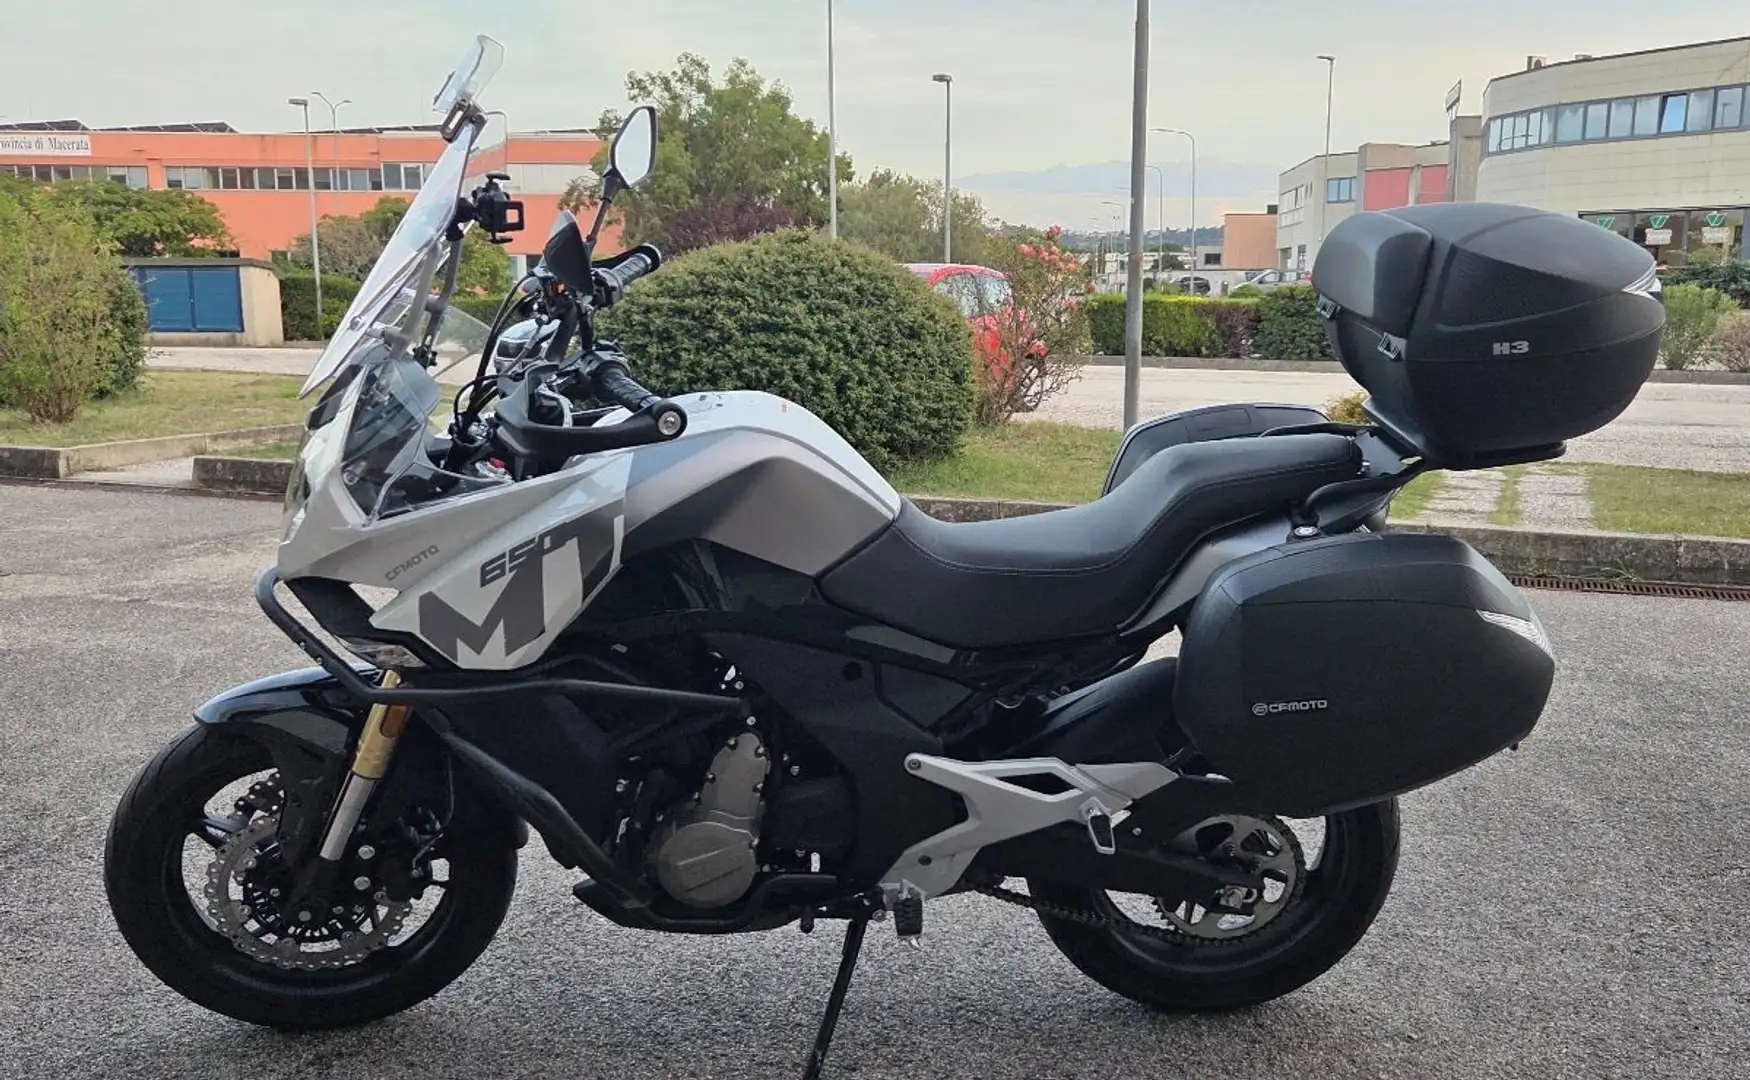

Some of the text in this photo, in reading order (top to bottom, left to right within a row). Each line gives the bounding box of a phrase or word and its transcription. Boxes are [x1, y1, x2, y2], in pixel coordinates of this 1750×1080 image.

[35, 136, 44, 149] di
[48, 137, 89, 150] Macerata
[1493, 340, 1530, 356] H3
[384, 543, 440, 582] CFMOTO
[1269, 699, 1328, 713] CFMOTO
